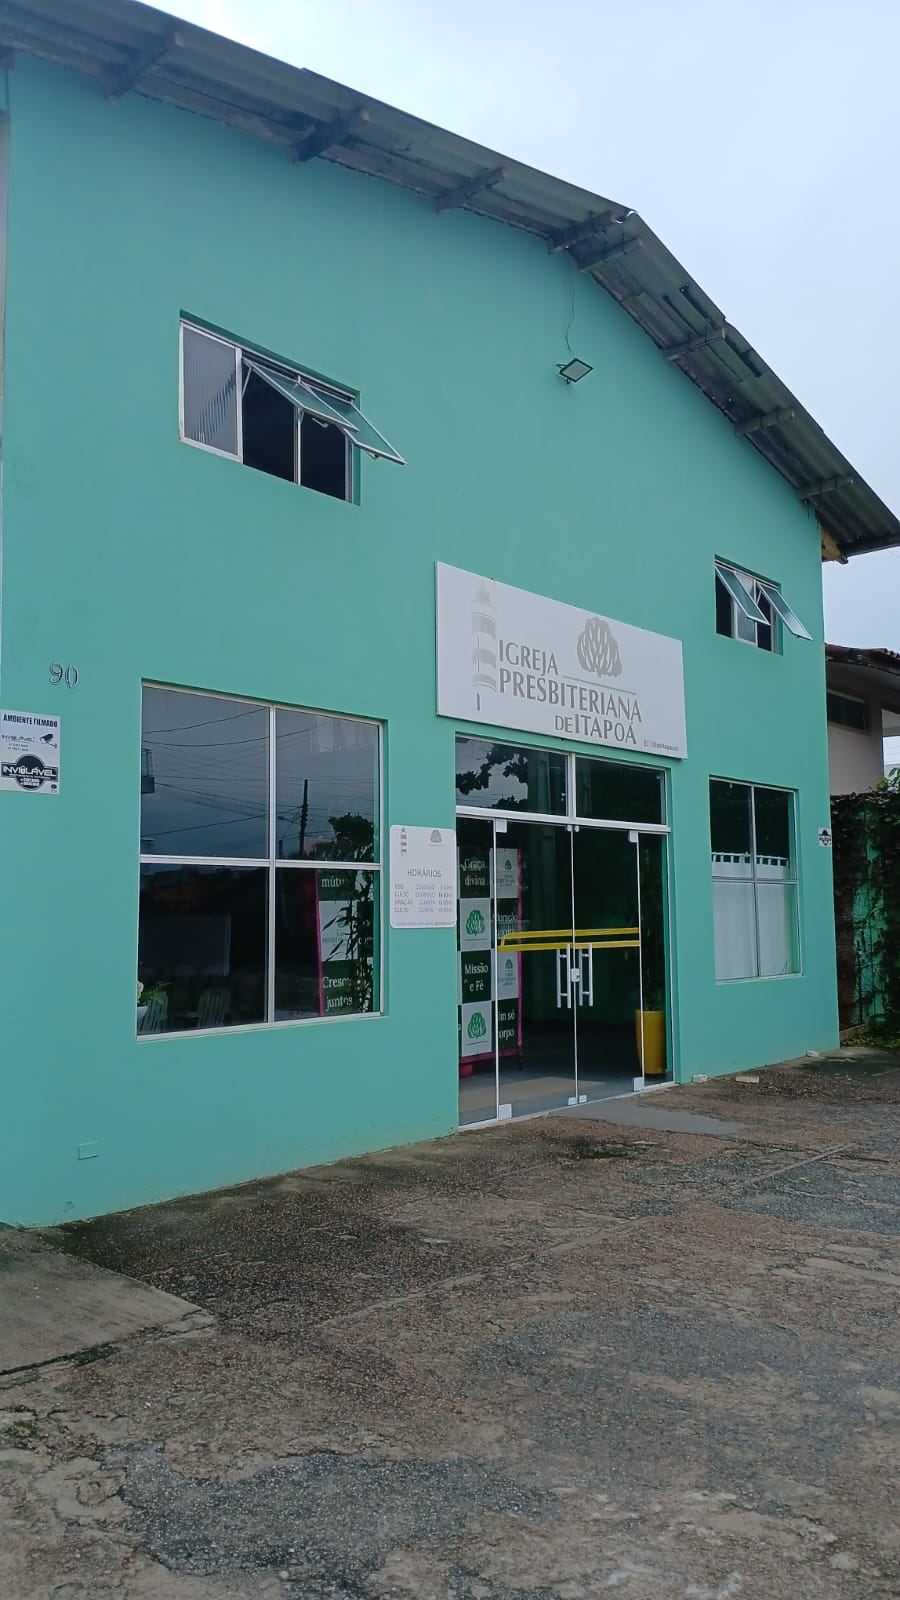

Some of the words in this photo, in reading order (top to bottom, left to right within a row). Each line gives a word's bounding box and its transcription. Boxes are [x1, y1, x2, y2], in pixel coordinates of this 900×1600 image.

[499, 640, 559, 676] IGREJA
[49, 662, 79, 689] 90
[499, 667, 642, 723] PRESBITERIANA
[3, 713, 33, 726] AMBIENTE
[33, 717, 58, 728] FILMADO
[555, 715, 573, 733] DE
[574, 713, 637, 745] ITAPOÁ
[407, 868, 442, 878] HORÁRIOS
[464, 875, 486, 886] divina
[464, 963, 489, 975] Missão
[469, 983, 475, 992] e
[475, 979, 485, 992] Fé
